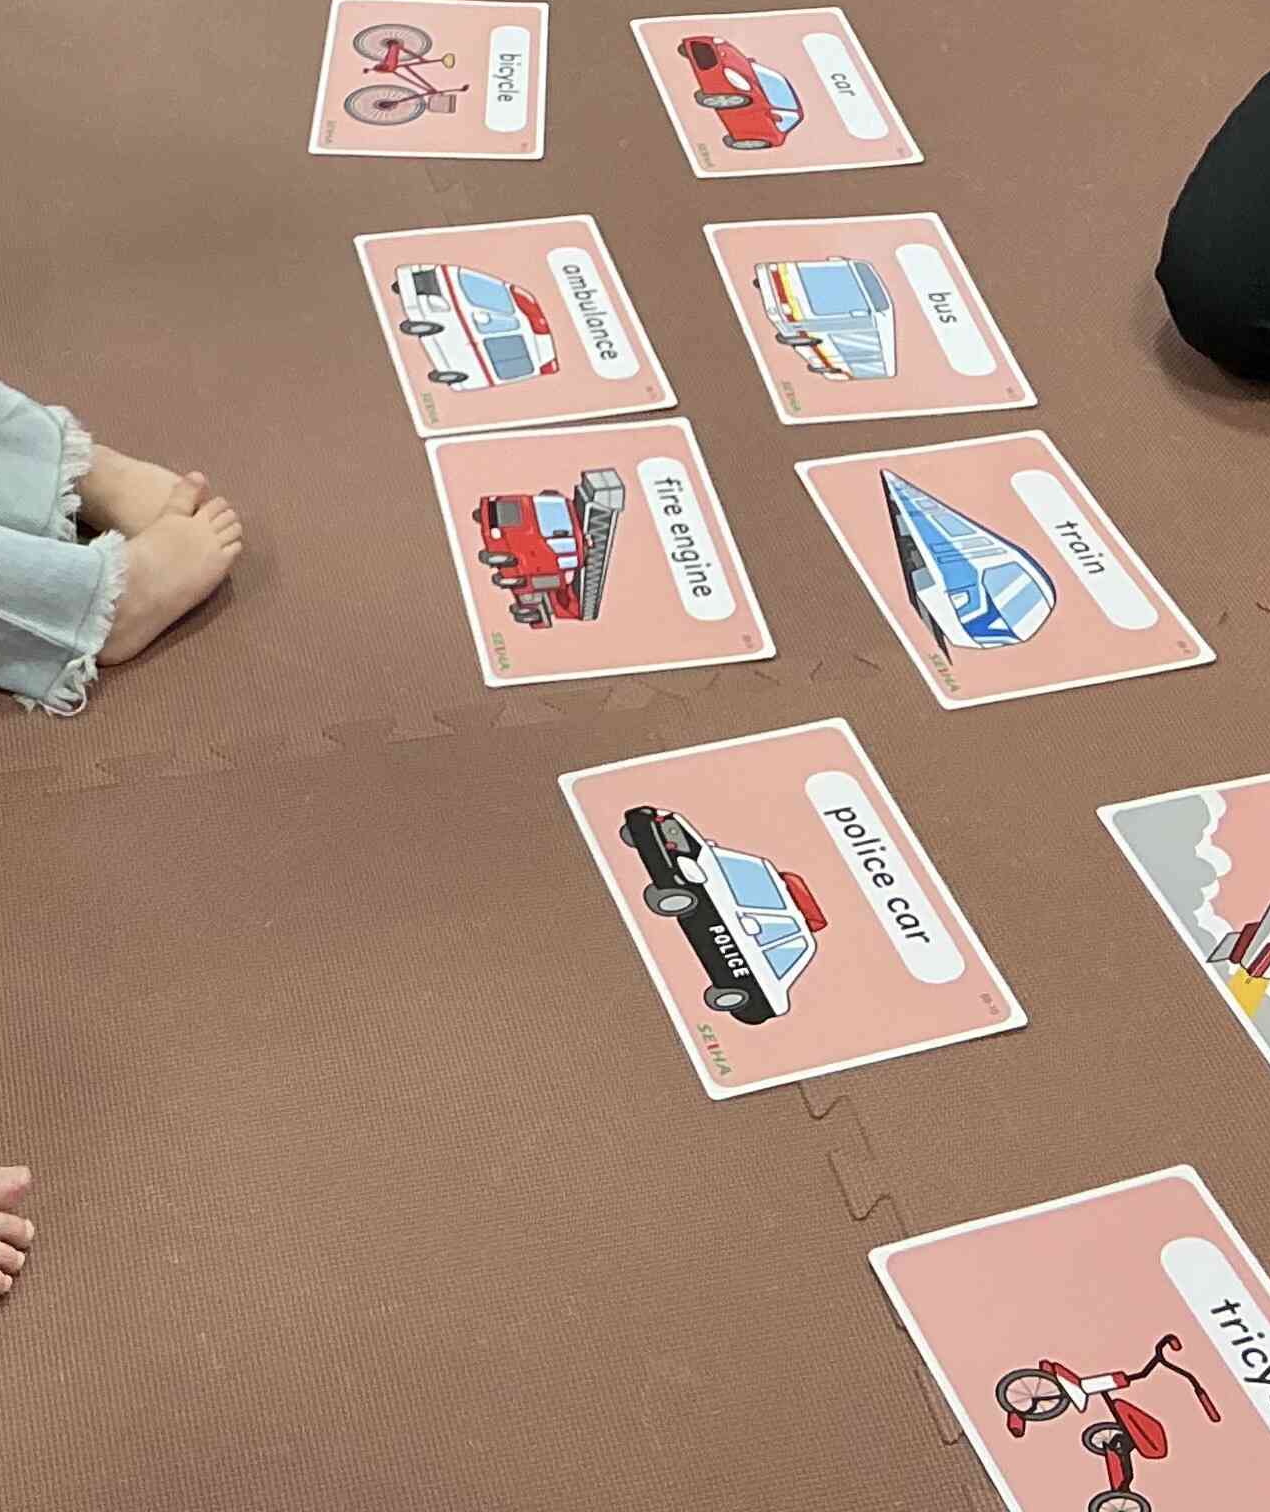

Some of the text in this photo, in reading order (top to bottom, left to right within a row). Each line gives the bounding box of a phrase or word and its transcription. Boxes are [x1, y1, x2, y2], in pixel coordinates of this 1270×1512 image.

[492, 53, 522, 103] bicycle
[830, 72, 856, 97] car
[562, 263, 618, 361] ambulance
[928, 291, 958, 324] bus
[654, 476, 713, 598] fire engine
[1054, 519, 1106, 576] train
[823, 806, 931, 944] police car
[708, 924, 750, 980] POLICE
[696, 1022, 732, 1077] SEIHA
